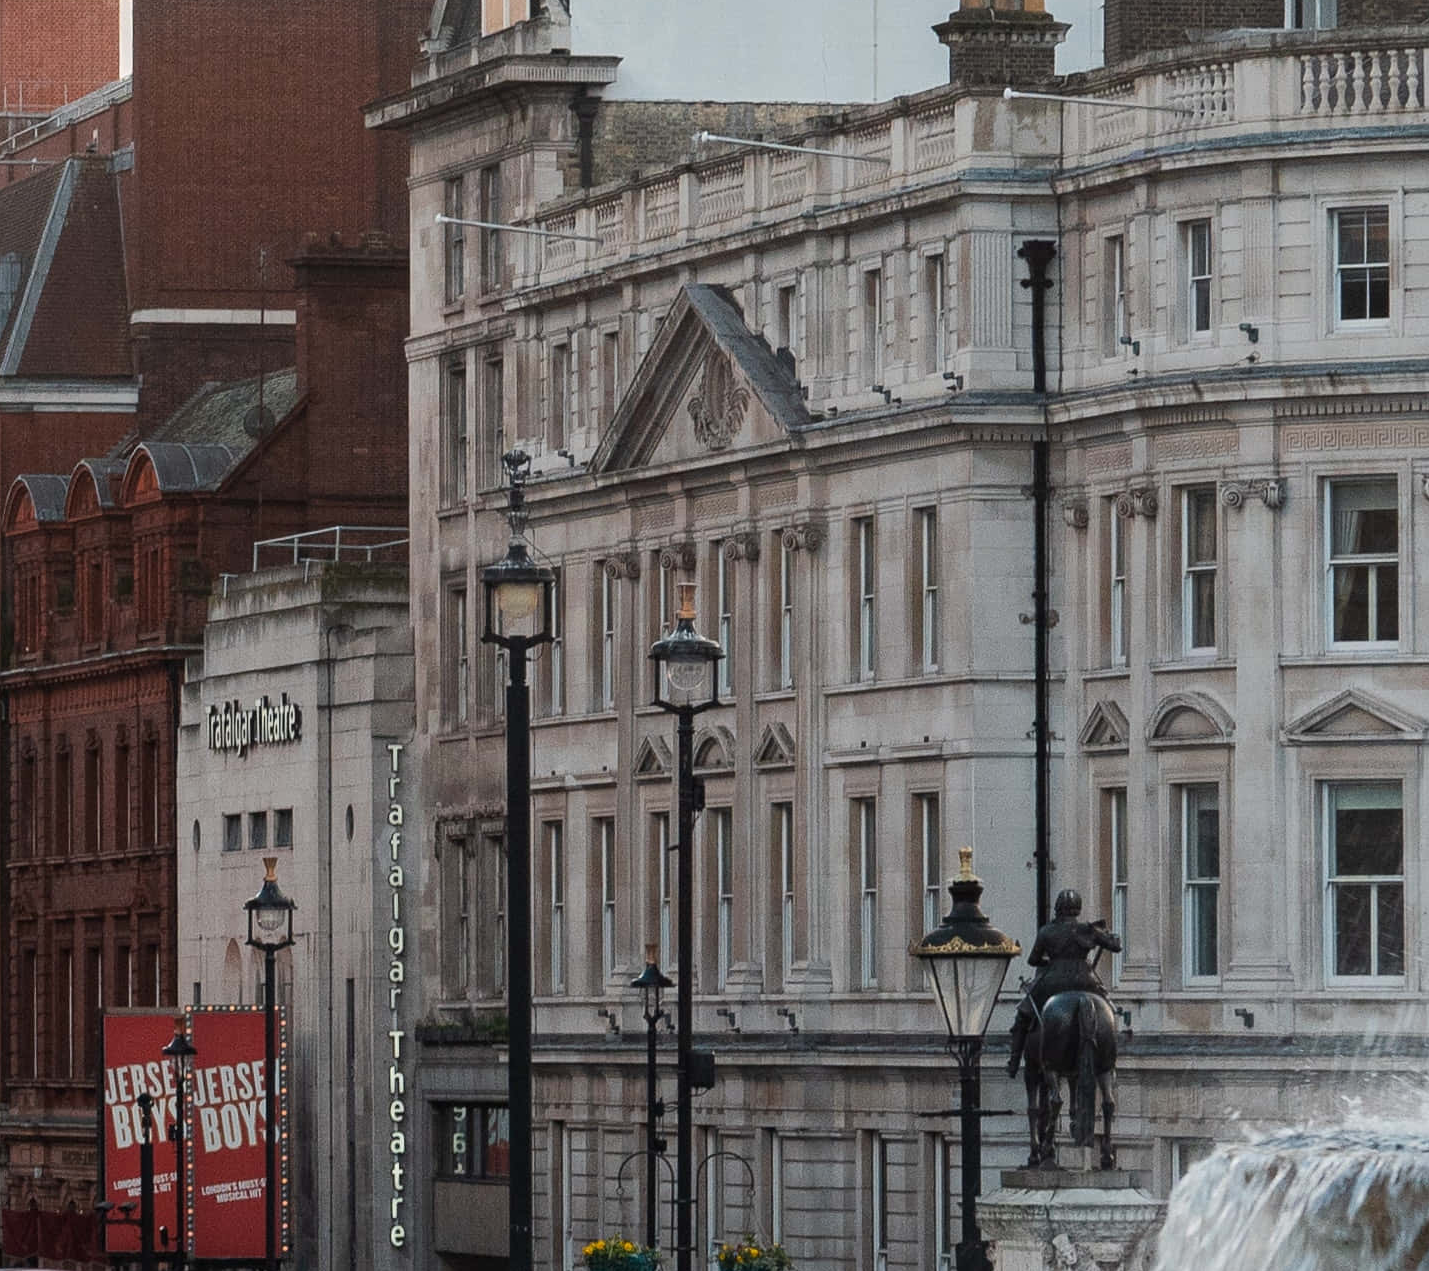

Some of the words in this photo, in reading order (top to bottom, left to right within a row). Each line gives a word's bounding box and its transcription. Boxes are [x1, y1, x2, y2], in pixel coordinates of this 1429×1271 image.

[205, 700, 252, 756] Trafalgar
[255, 694, 295, 743] Theatre
[388, 743, 404, 1009] Trafalgar
[389, 1031, 405, 1247] Theatre
